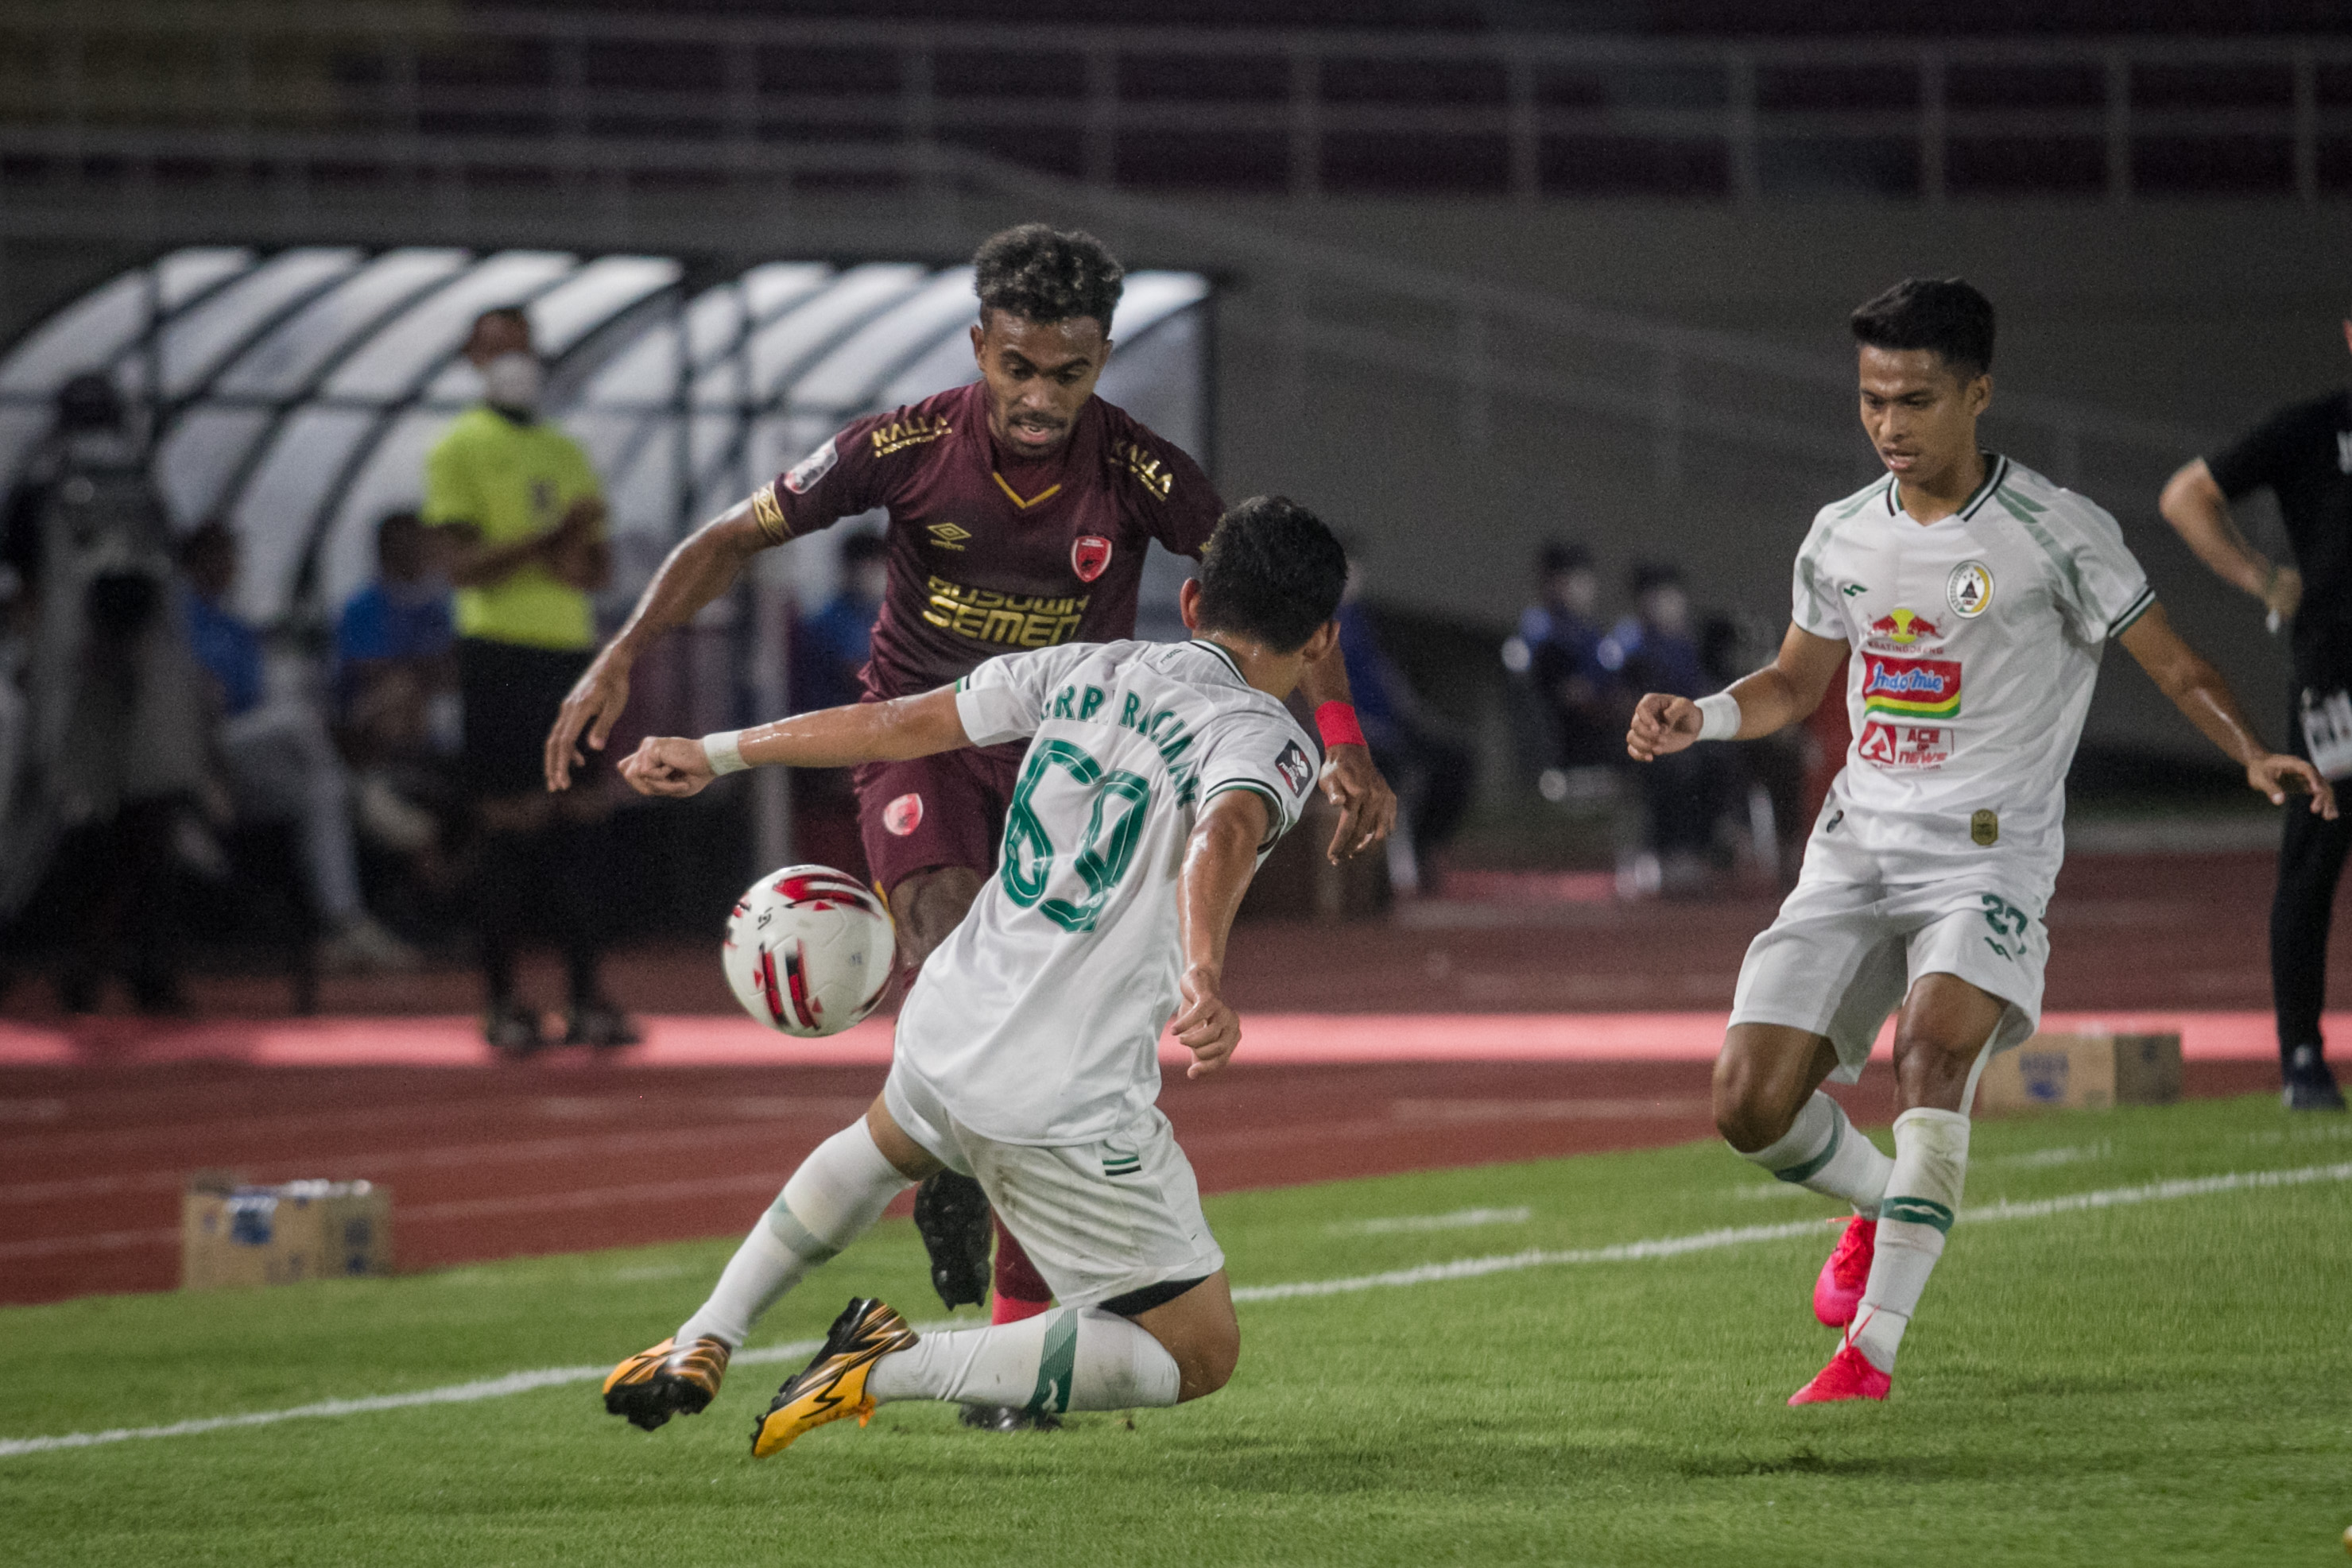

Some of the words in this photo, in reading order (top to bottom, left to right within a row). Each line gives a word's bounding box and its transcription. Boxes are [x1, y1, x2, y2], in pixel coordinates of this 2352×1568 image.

[872, 416, 947, 447] KALLA
[1906, 728, 1939, 744] ACE
[1001, 738, 1152, 933] 69
